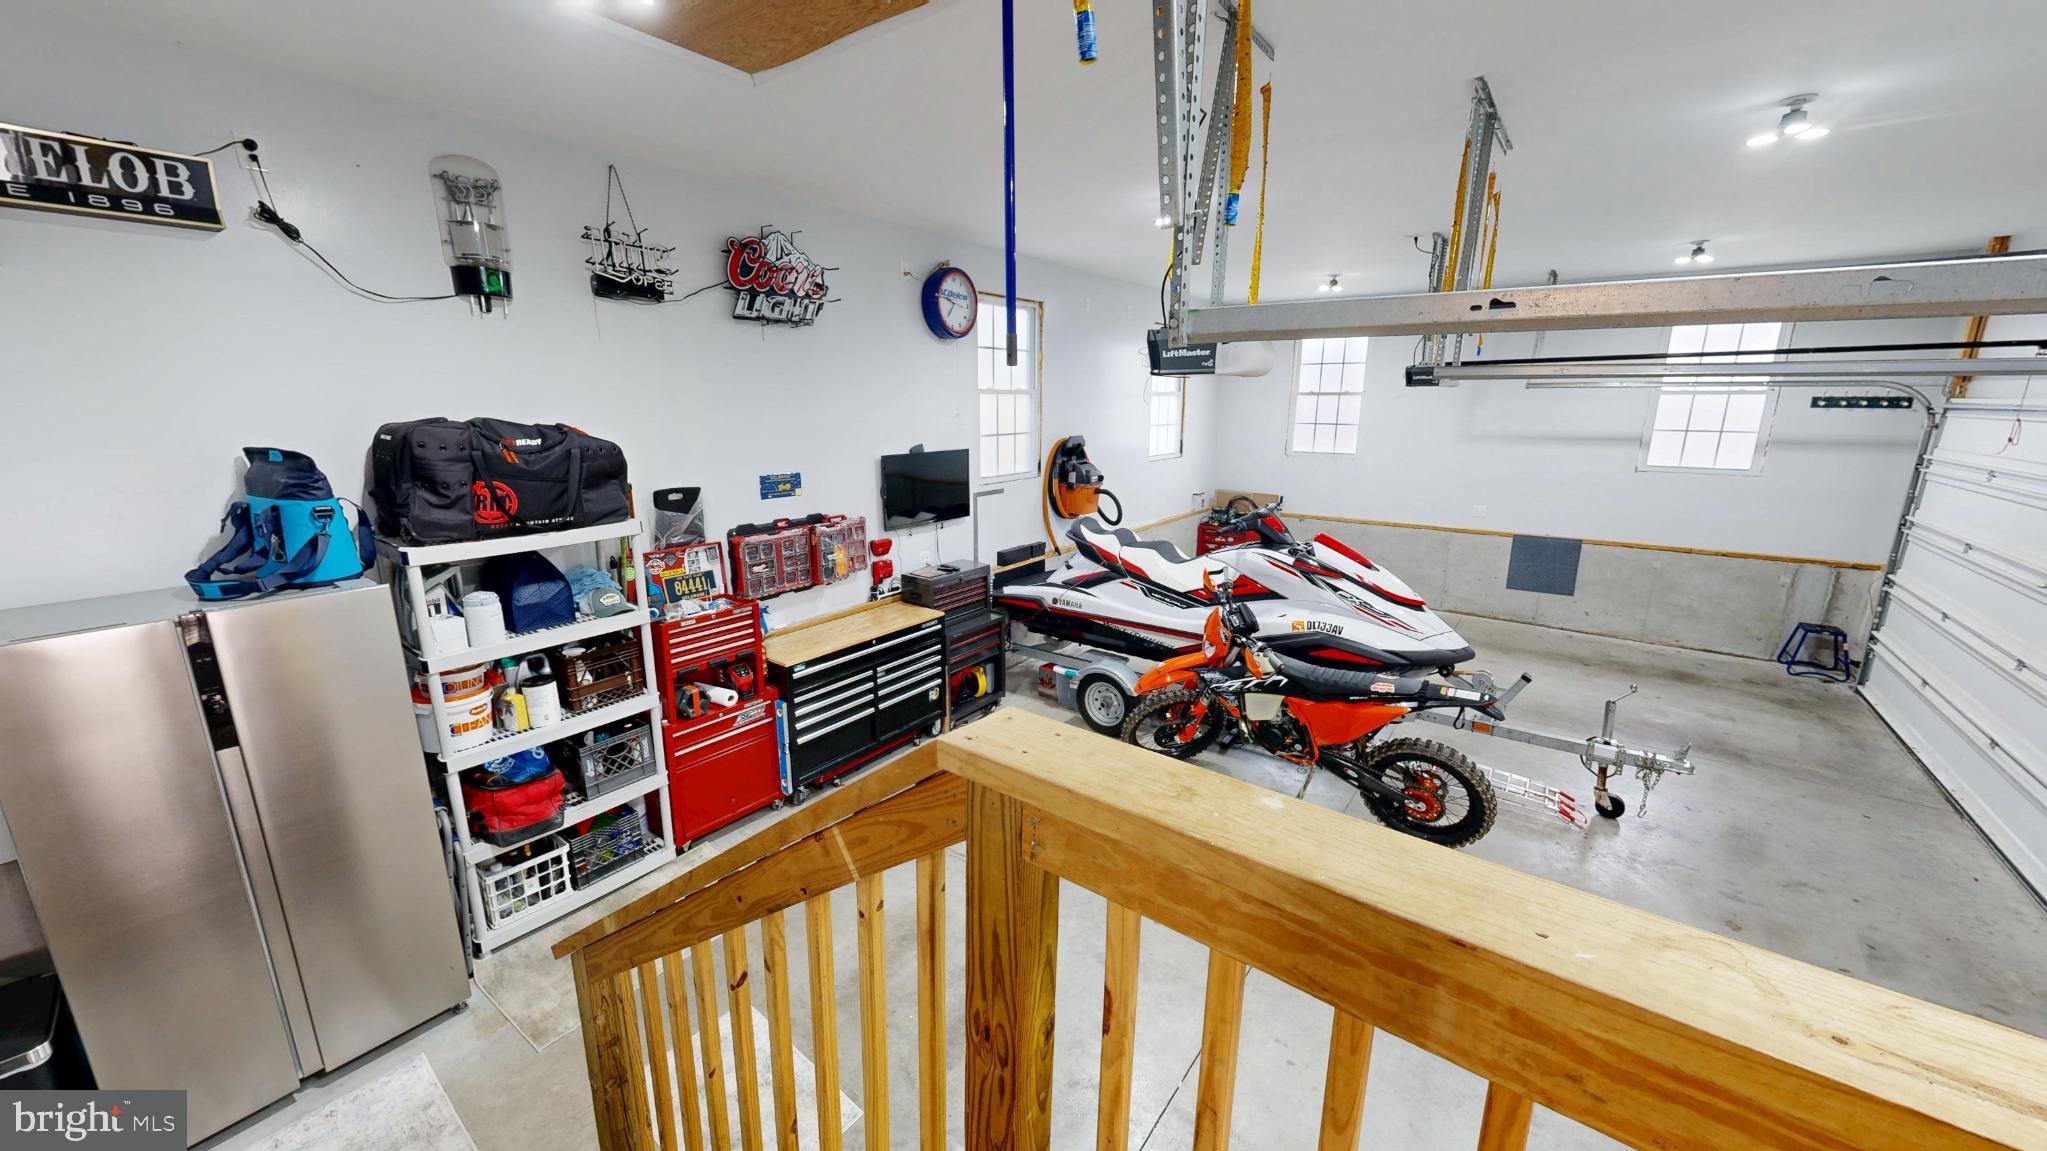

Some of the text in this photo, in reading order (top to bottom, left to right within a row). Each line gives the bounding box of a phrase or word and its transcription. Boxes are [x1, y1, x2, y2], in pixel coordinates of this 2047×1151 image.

[67, 191, 175, 216] 1896
[1162, 349, 1211, 358] LiftMaster
[674, 576, 708, 596] 84441
[1059, 598, 1083, 609] YAMAHA
